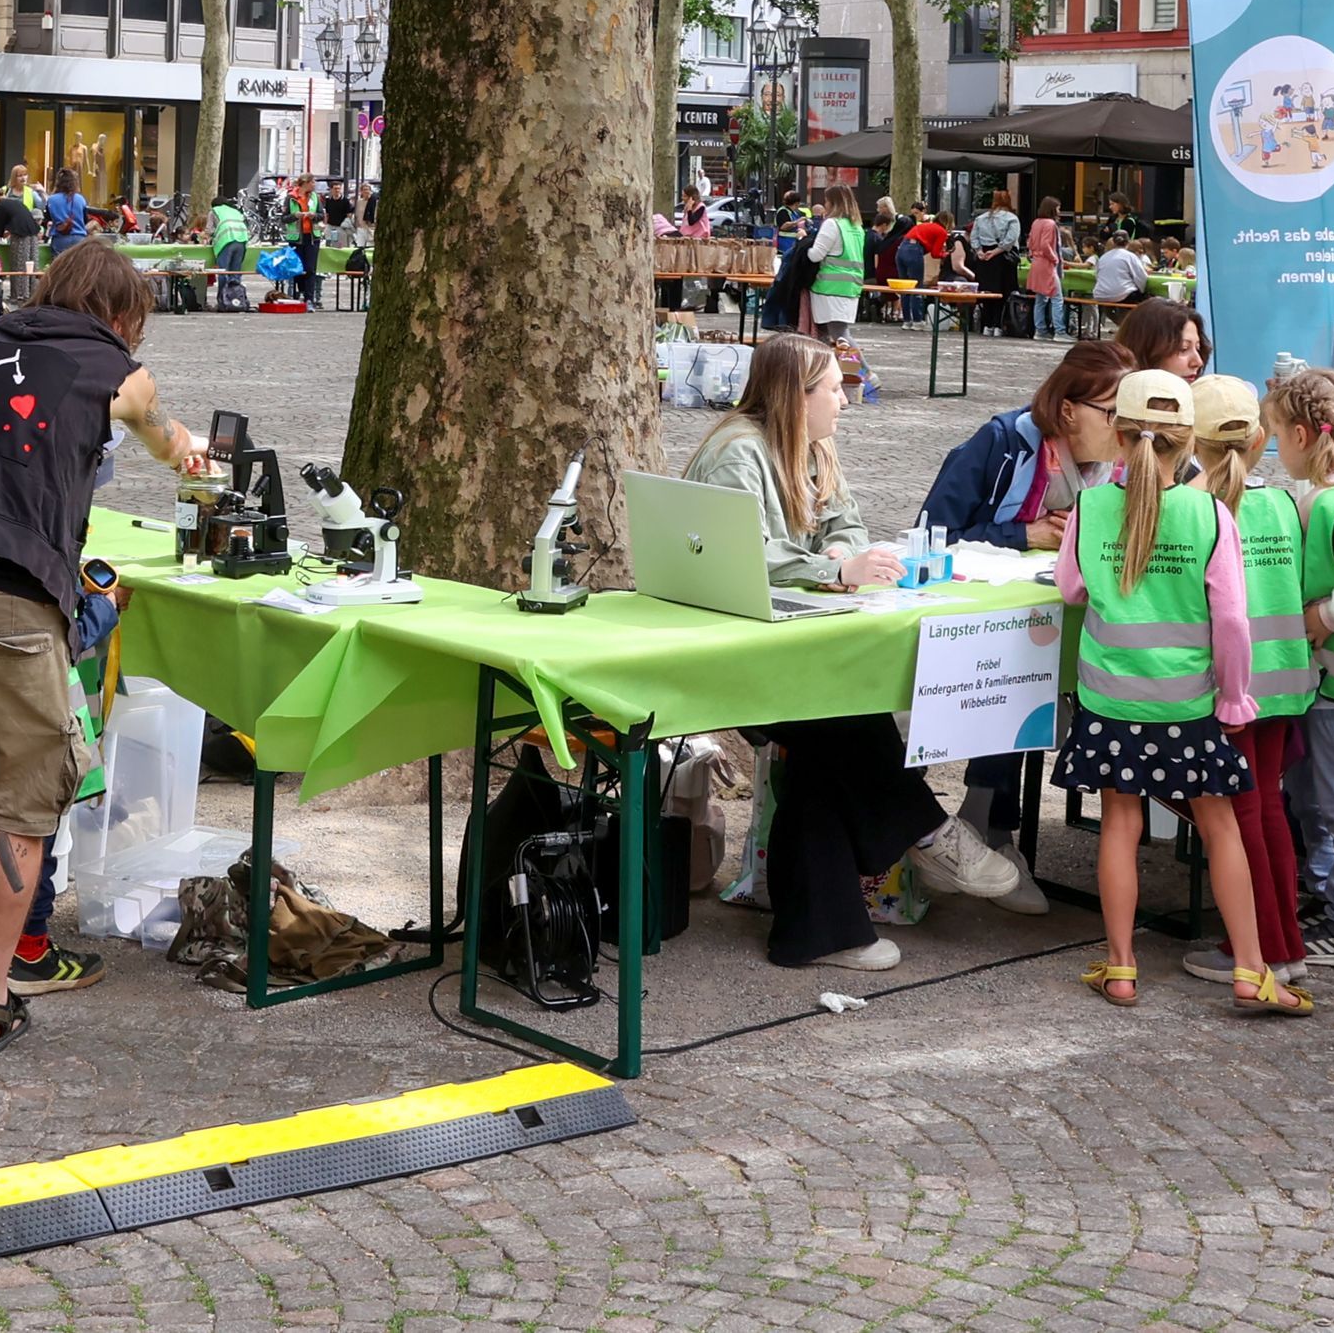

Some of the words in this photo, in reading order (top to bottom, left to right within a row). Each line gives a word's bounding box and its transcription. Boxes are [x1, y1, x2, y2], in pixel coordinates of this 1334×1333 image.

[685, 111, 718, 125] CENTER
[983, 134, 995, 147] eis
[998, 133, 1031, 149] BREDA
[1172, 146, 1191, 160] eis
[1155, 543, 1194, 553] ergarten
[1100, 554, 1112, 562] An
[929, 623, 981, 640] Längster
[983, 612, 1053, 633] Forschertisch
[976, 657, 1001, 671] Fröbel
[918, 683, 973, 697] Kindergarten
[975, 680, 982, 690] &
[984, 671, 1052, 688] Familienzentrum
[960, 694, 1007, 710] Wibbelstätz
[924, 748, 948, 761] Fröbel
